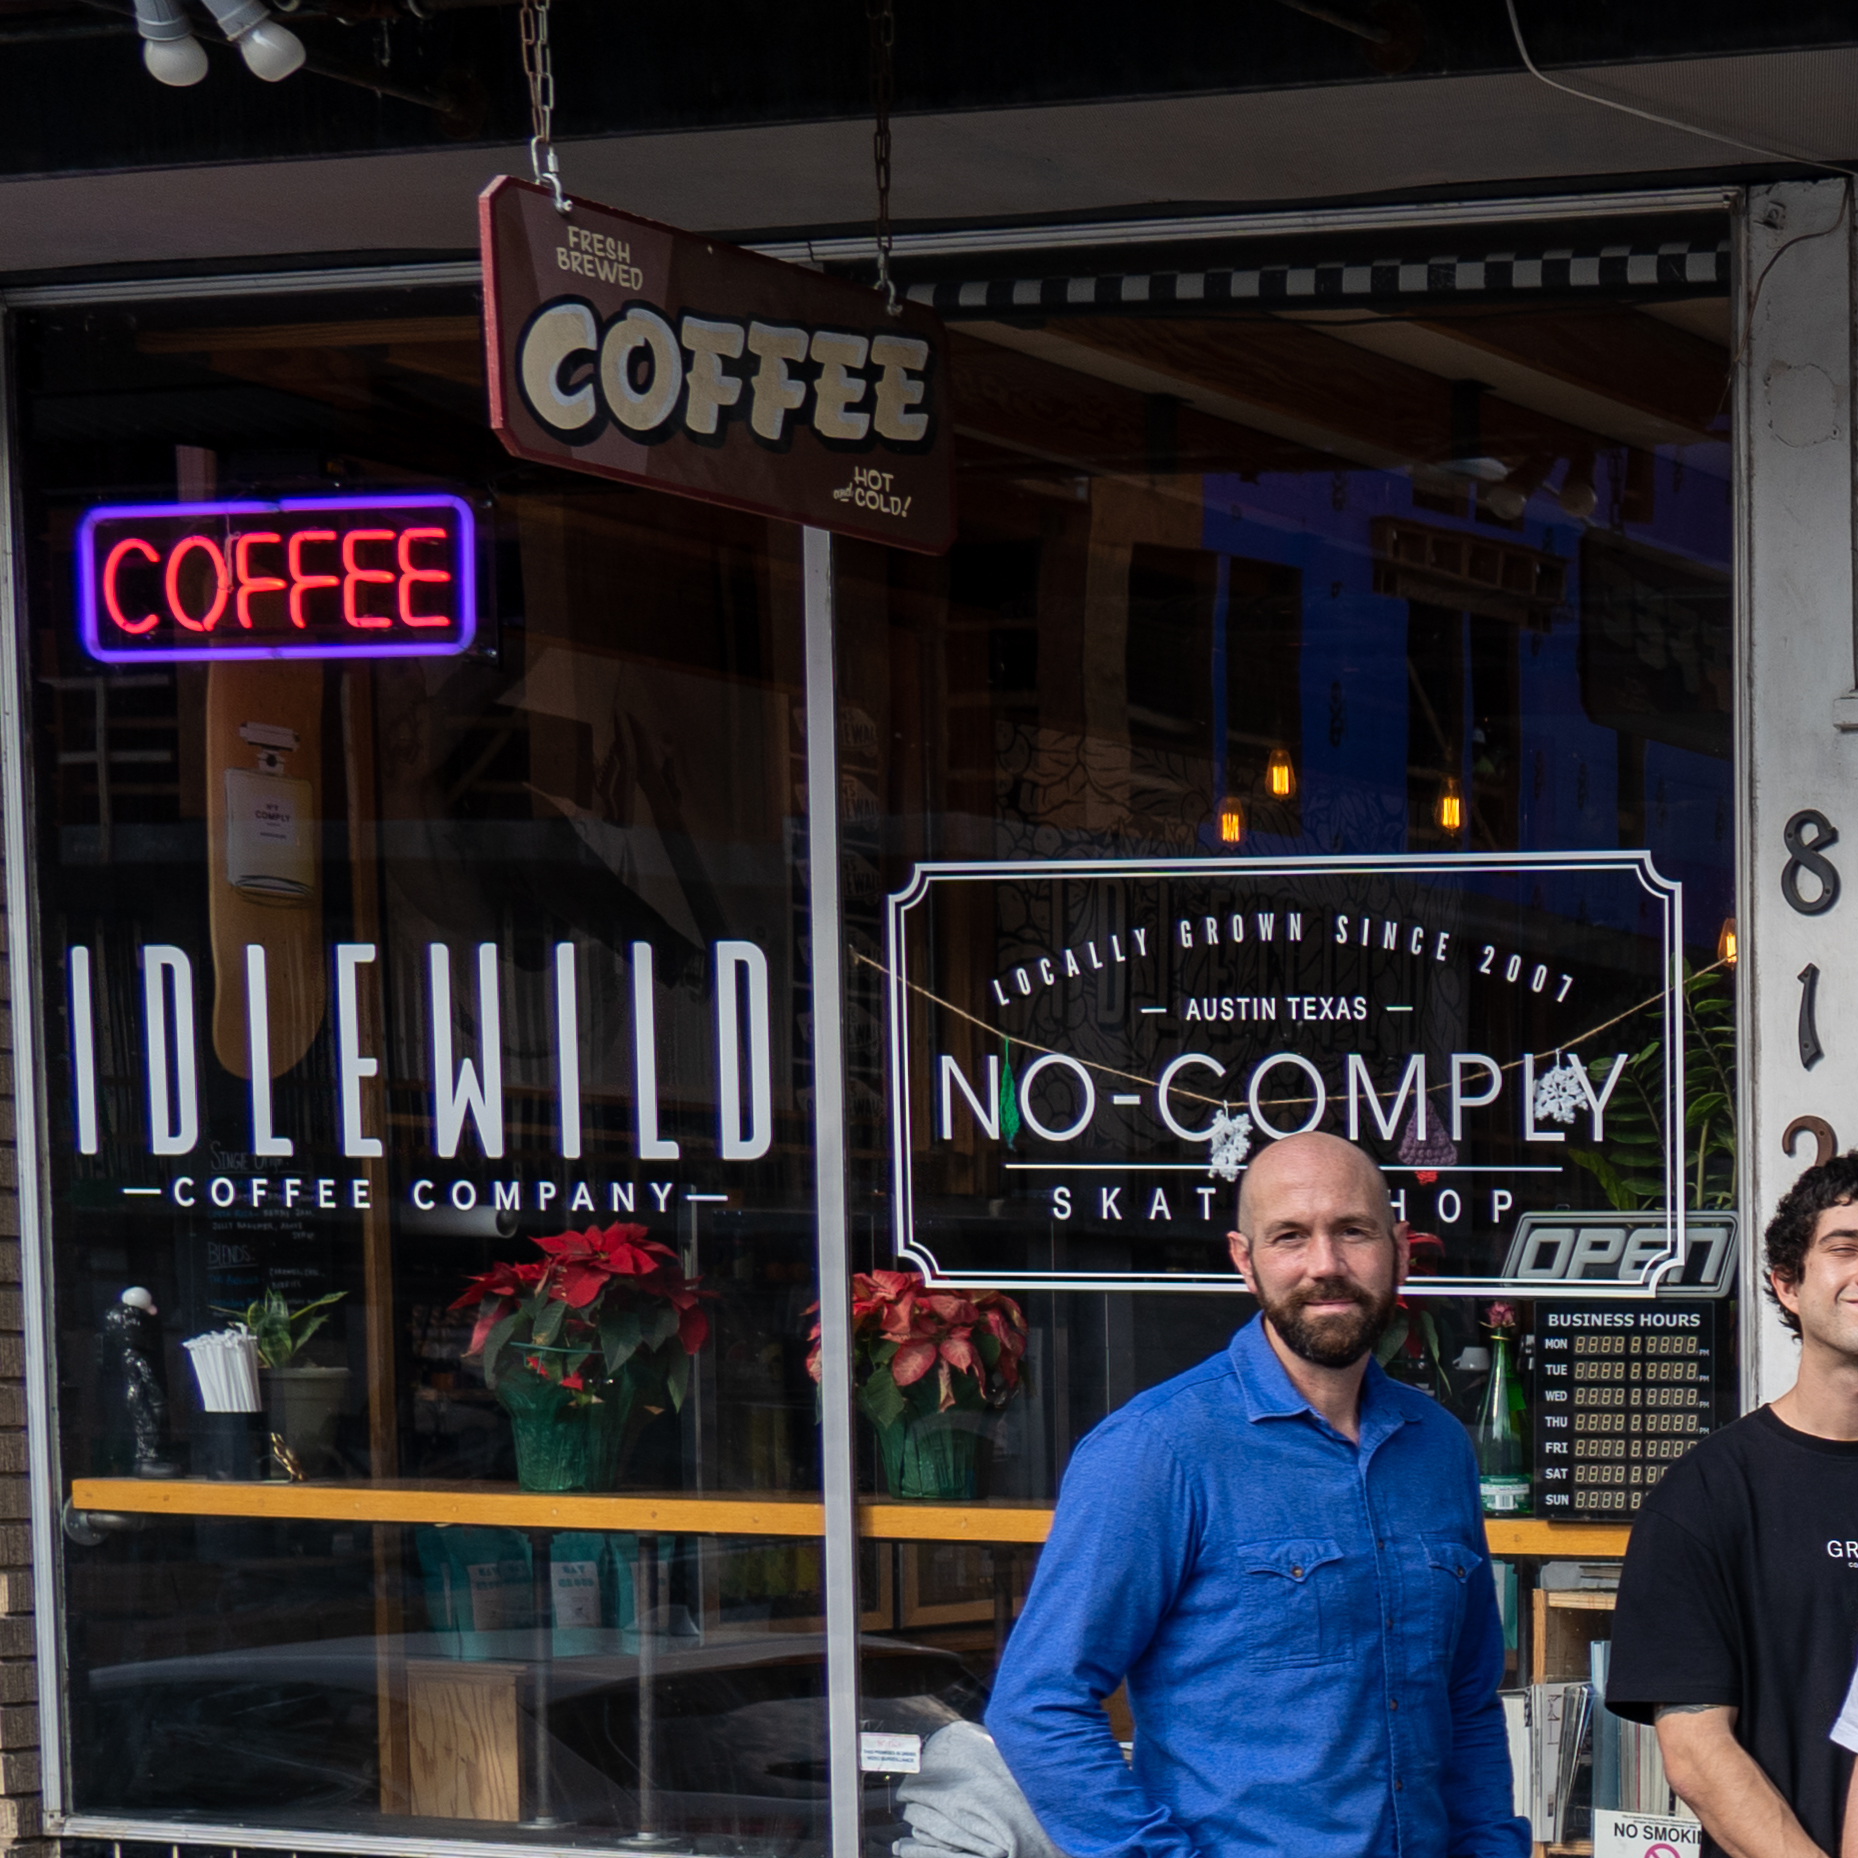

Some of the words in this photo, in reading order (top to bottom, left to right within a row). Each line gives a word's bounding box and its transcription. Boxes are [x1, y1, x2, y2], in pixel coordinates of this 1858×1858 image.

[568, 226, 630, 265] FRESH
[556, 246, 643, 292] BREWED
[520, 303, 930, 443] COFFEE
[853, 466, 894, 494] HOT
[853, 486, 912, 518] COLD!
[102, 527, 451, 634] COFFEE
[992, 927, 1150, 1007] LOCALLY
[1181, 912, 1303, 949] GROWN
[1335, 914, 1452, 961] SINCE
[1479, 944, 1576, 1006] 2007
[1186, 996, 1277, 1022] AUSTIN
[1287, 996, 1369, 1021] TEXAS
[70, 940, 775, 1162] IDLEWILD
[940, 1053, 1629, 1144] NO-COMPLY
[173, 1177, 373, 1210] COFFEE
[413, 1180, 675, 1214] COMPANY
[1052, 1187, 1218, 1222] SKAT
[1387, 1189, 1513, 1224] HOP
[1548, 1313, 1634, 1328] BUSINESS
[1640, 1313, 1701, 1328] HOURS
[1545, 1338, 1568, 1350] MON
[1545, 1364, 1568, 1376] TUE
[1545, 1390, 1568, 1402] WED
[1545, 1416, 1568, 1428] THU
[1545, 1442, 1568, 1454] FRI
[1545, 1468, 1568, 1480] SAT
[1545, 1494, 1568, 1506] SUN
[1614, 1821, 1639, 1839] NO
